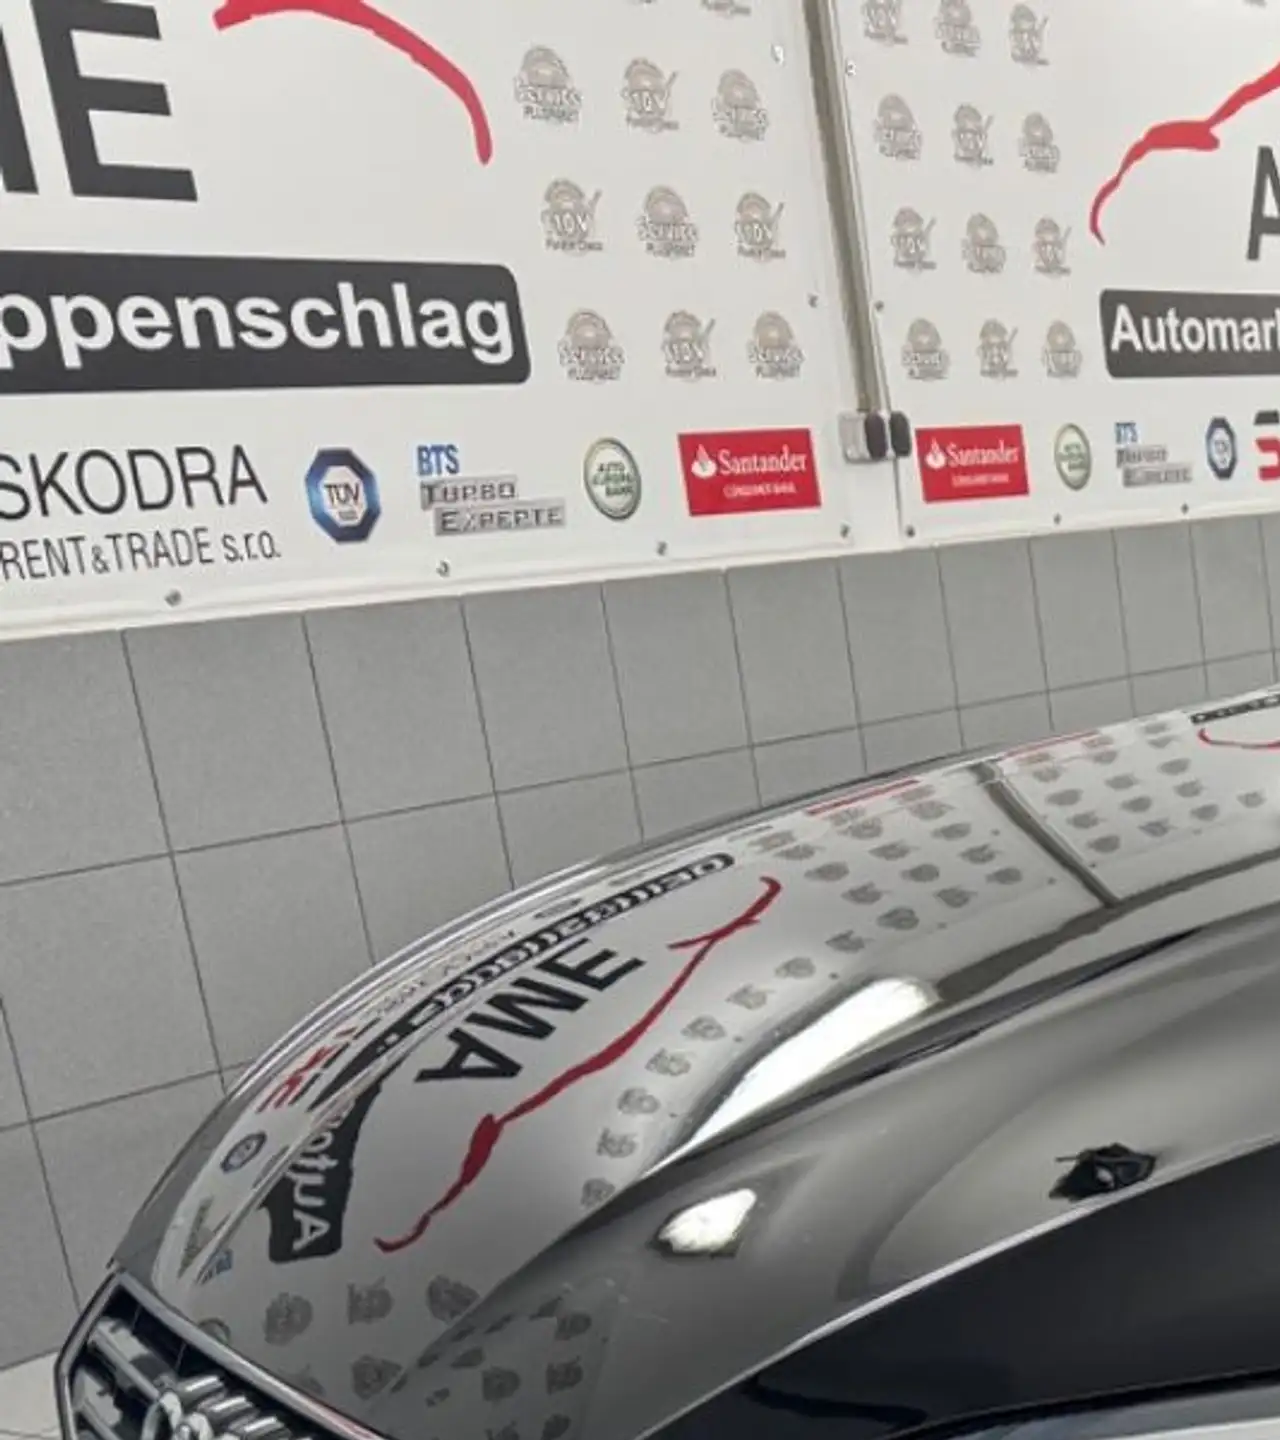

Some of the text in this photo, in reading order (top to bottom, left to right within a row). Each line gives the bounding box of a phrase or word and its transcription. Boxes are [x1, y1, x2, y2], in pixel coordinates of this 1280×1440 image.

[0, 0, 198, 201] E
[417, 444, 459, 476] BTS
[717, 444, 808, 476] Santander
[945, 440, 1019, 468] Santander
[0, 444, 268, 520] SKODRA
